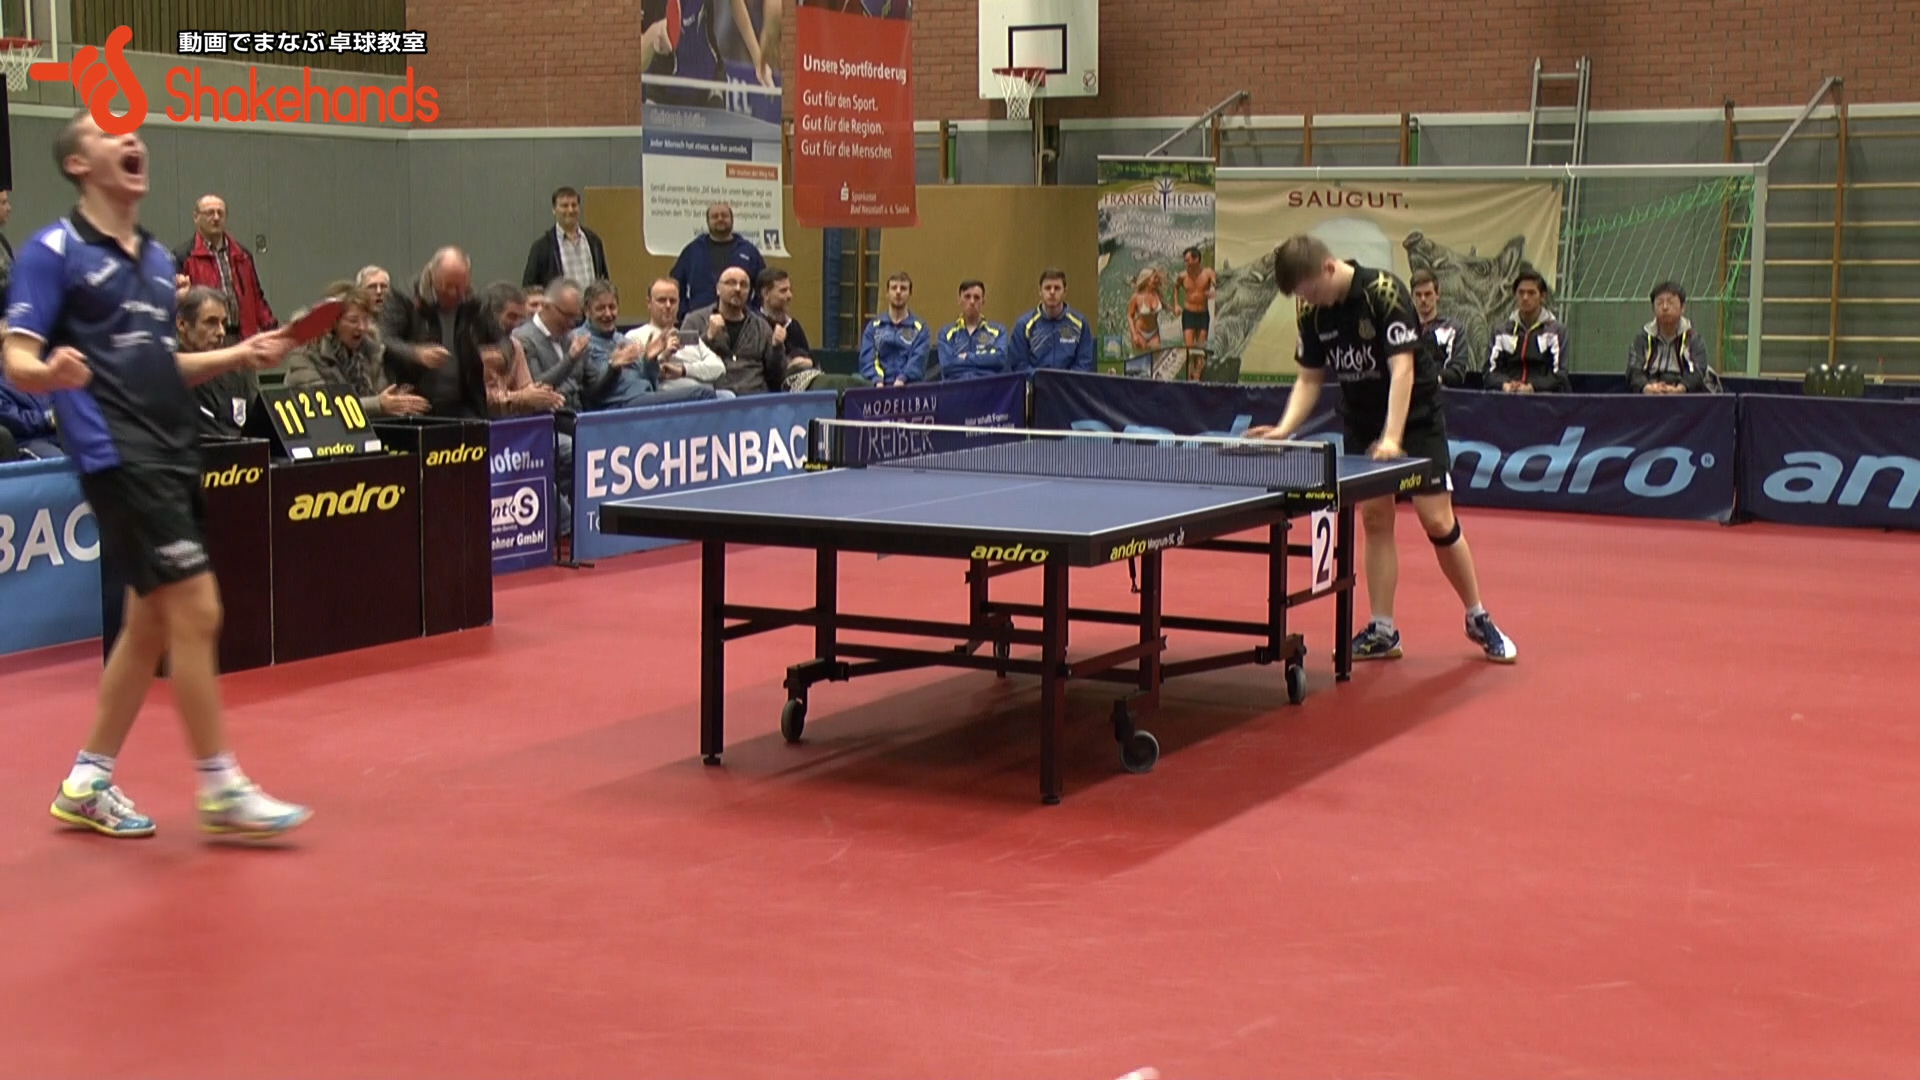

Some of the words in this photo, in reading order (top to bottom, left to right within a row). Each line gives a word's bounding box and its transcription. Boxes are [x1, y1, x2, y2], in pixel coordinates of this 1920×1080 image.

[803, 54, 838, 74] Unsere
[803, 89, 822, 106] Gut
[824, 91, 836, 107] für
[837, 93, 851, 108] den
[852, 95, 879, 112] Sport.
[802, 114, 822, 131] Gut
[823, 115, 837, 131] für
[838, 117, 850, 133] die
[851, 118, 884, 138] Region.
[801, 139, 820, 156] Gut
[823, 139, 836, 157] für
[838, 141, 850, 157] die
[1288, 190, 1410, 210] SAUGUT.
[274, 400, 305, 435] 11
[299, 393, 315, 418] 2
[316, 391, 332, 416] 2
[334, 395, 366, 431] 10
[863, 396, 937, 417] MODELLBAU
[316, 442, 355, 457] andro
[426, 443, 484, 467] andro
[1447, 426, 1698, 498] ndro
[202, 464, 260, 489] ndro
[288, 482, 401, 521] andro
[1305, 491, 1334, 500] andro
[516, 529, 545, 546] GmbH
[1110, 537, 1147, 561] andro
[970, 543, 1048, 563] andro
[1316, 516, 1331, 585] 2
